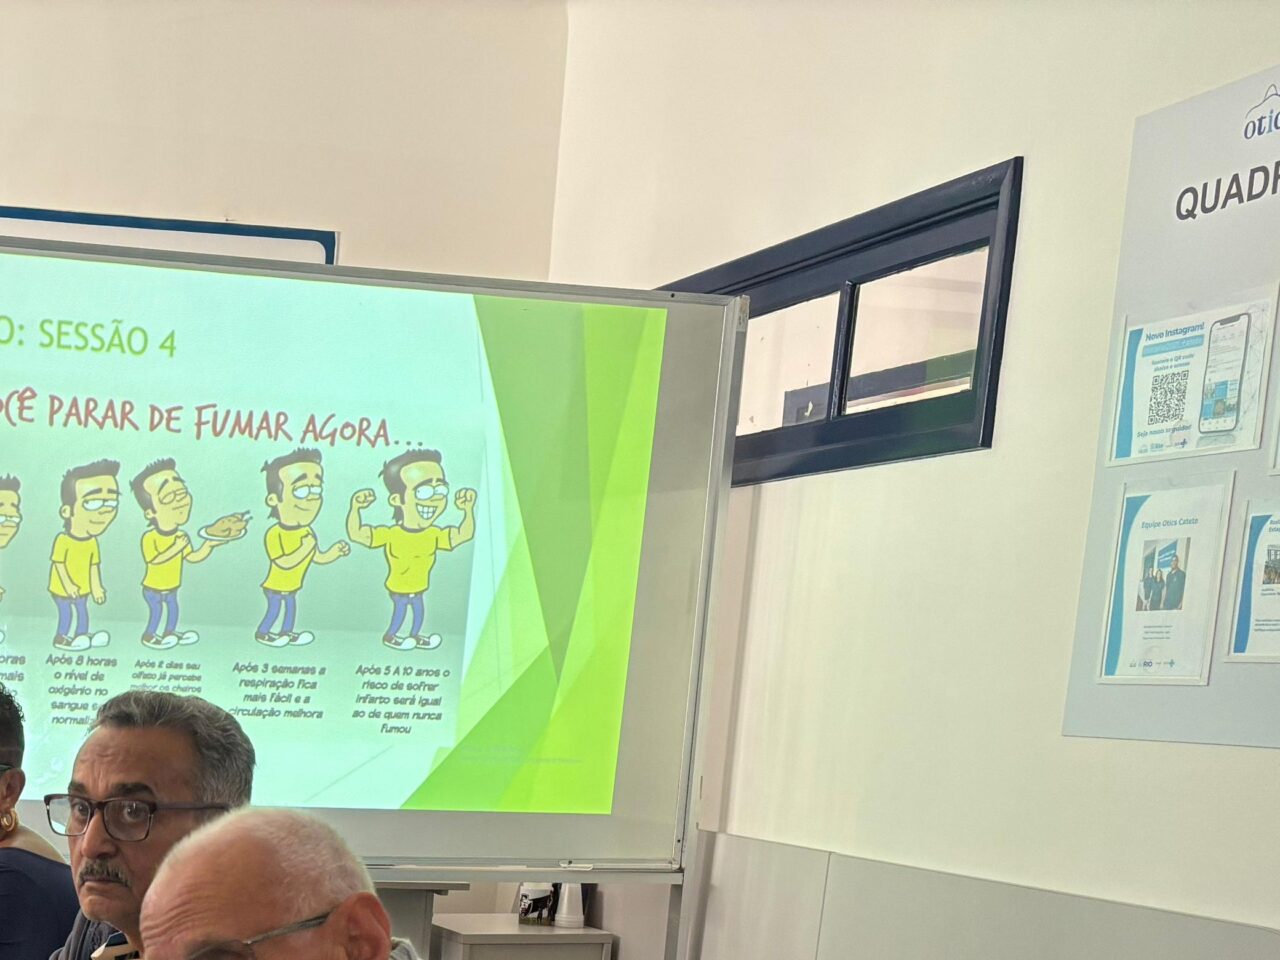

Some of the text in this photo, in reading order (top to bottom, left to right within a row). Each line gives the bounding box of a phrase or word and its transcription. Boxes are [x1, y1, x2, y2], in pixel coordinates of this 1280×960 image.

[1165, 321, 1205, 337] Instagram!
[38, 318, 150, 356] SESSÃO
[158, 329, 177, 357] 4
[48, 394, 140, 431] PARAR
[149, 404, 184, 433] DE
[194, 403, 293, 442] FUMAR
[46, 653, 117, 667] Após 8 horas
[135, 660, 156, 669] Após
[165, 661, 183, 669] dias
[54, 668, 105, 681] o nível de
[232, 662, 326, 675] Após 3 semanas a
[355, 665, 381, 677] Após
[383, 665, 391, 676] 5
[402, 666, 413, 676] 10
[415, 669, 440, 677] anos
[442, 669, 450, 678] o
[48, 684, 108, 696] oxigênio no
[239, 678, 295, 690] respiração
[362, 680, 387, 690] risco
[390, 681, 404, 691] de
[243, 692, 267, 702] mais
[393, 694, 416, 705] será
[51, 701, 89, 712] sangue
[228, 706, 323, 719] circulação melhora
[352, 708, 442, 721] ao de quem nunca
